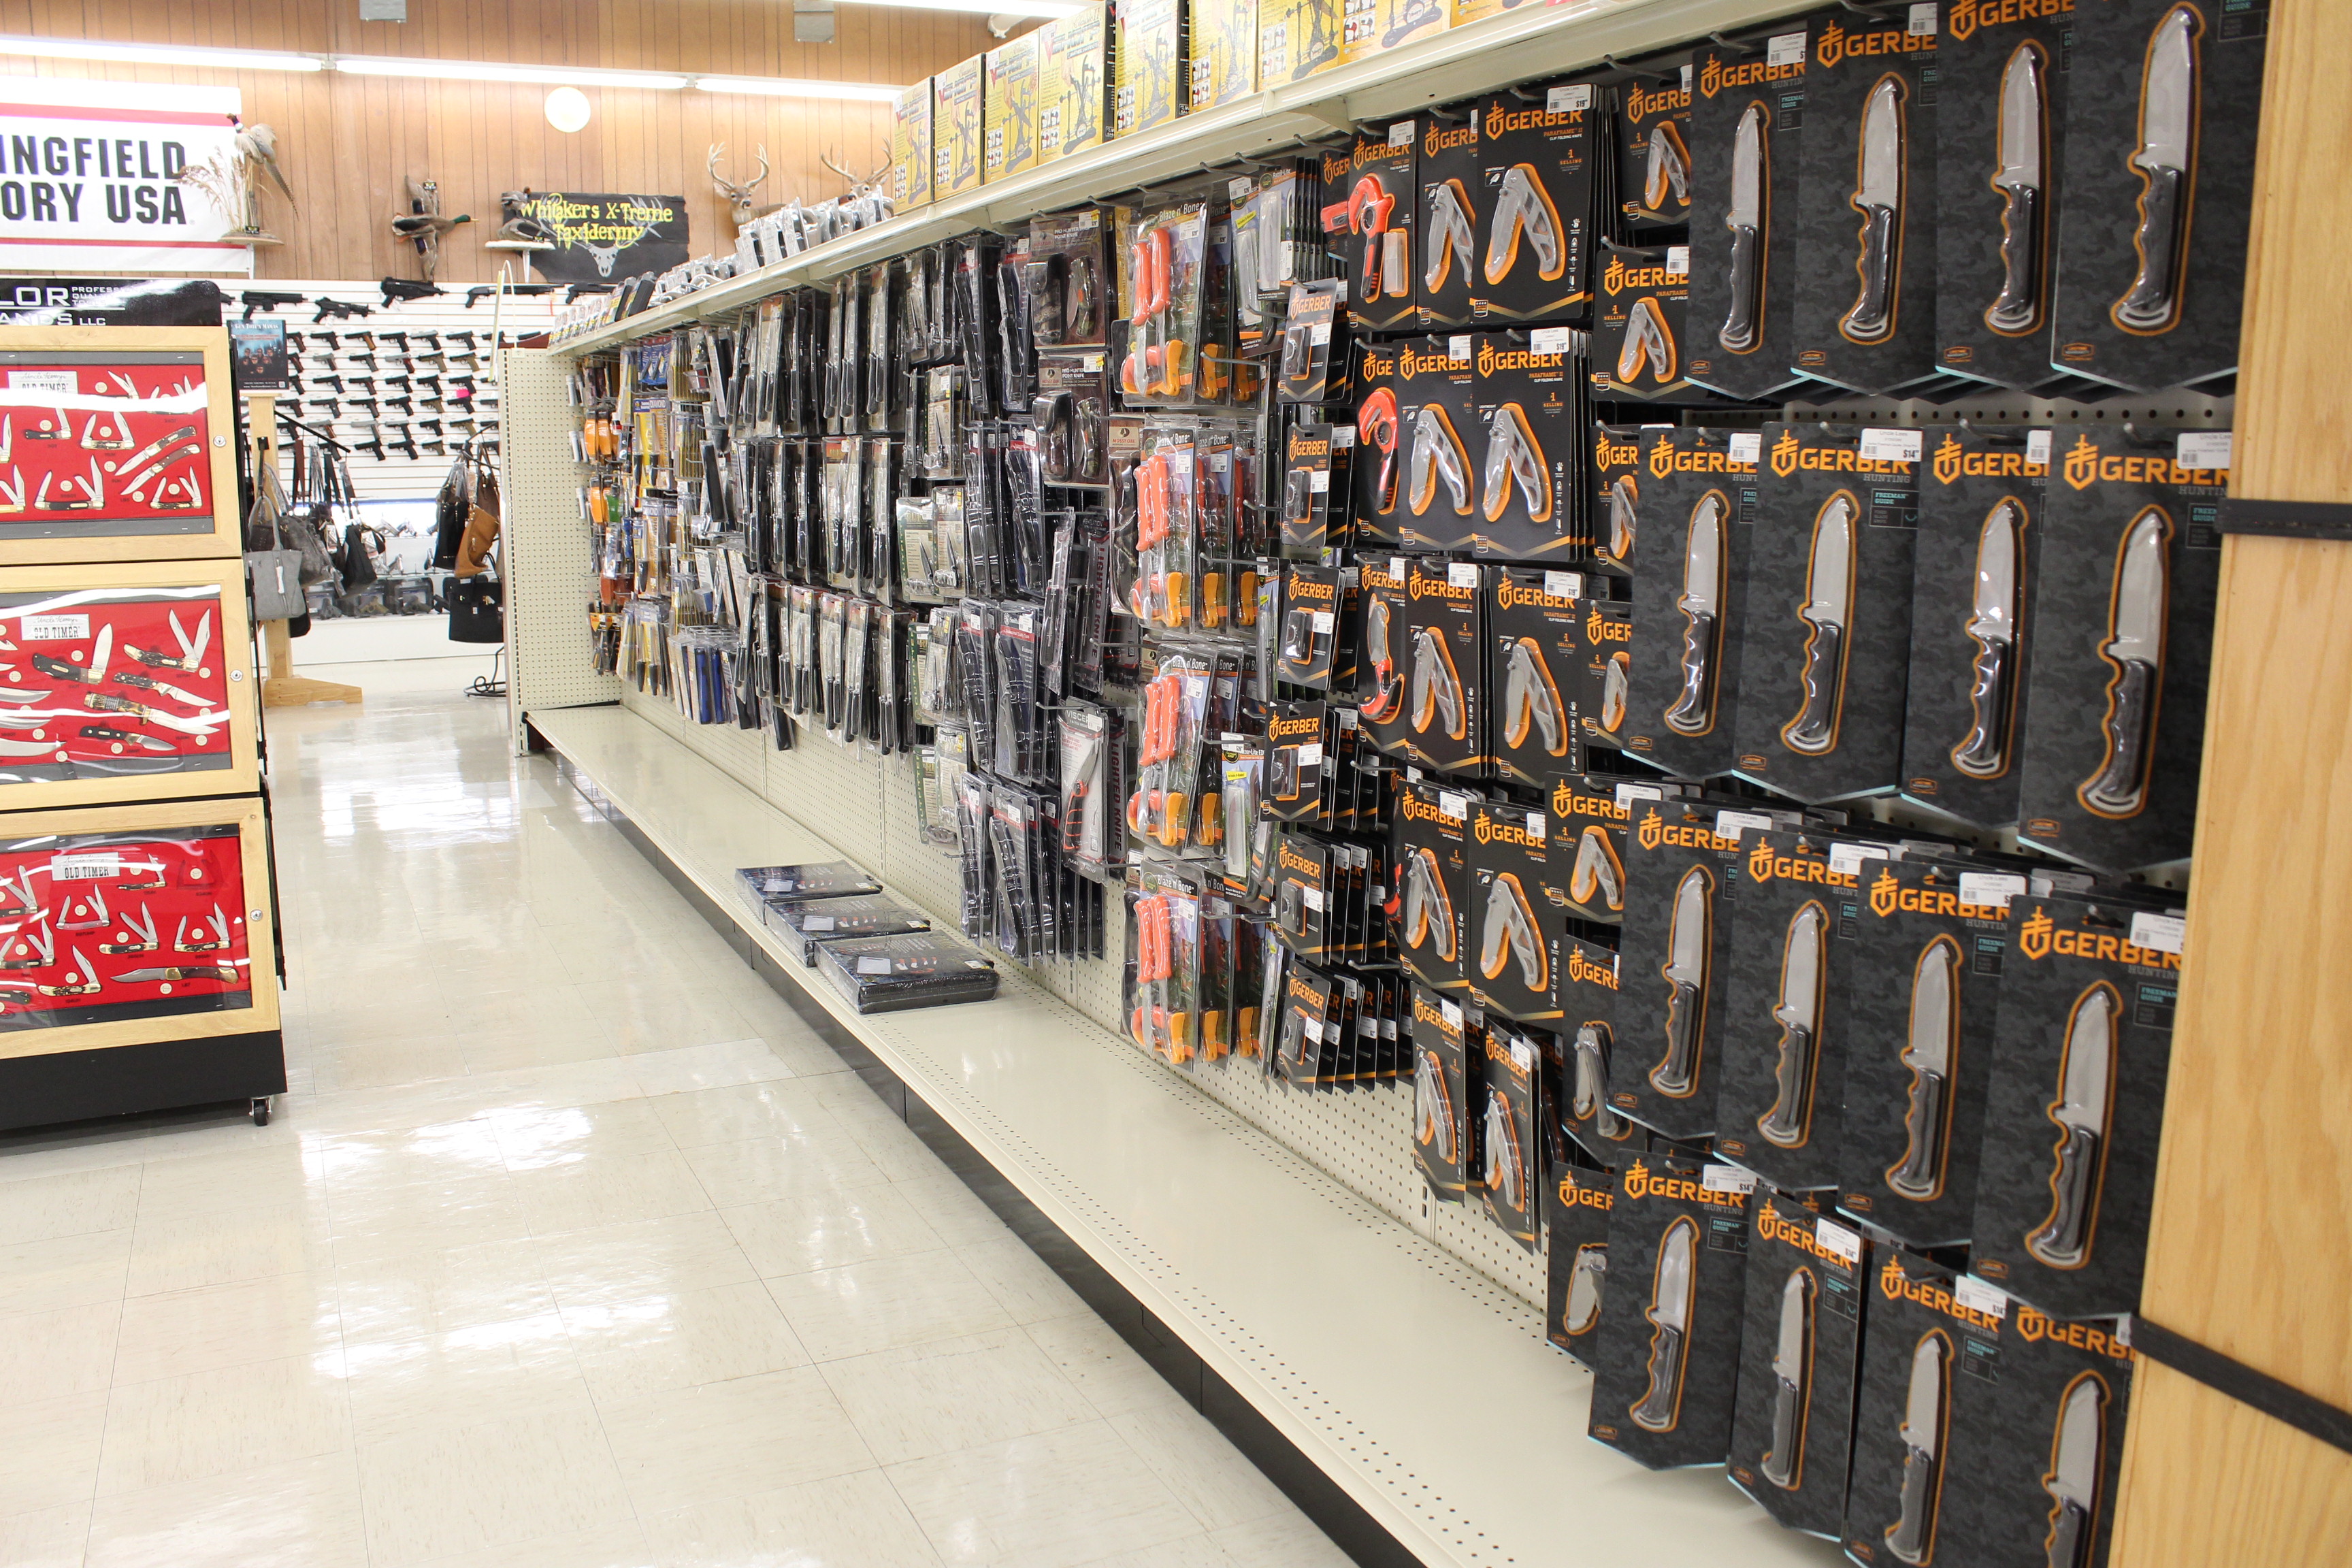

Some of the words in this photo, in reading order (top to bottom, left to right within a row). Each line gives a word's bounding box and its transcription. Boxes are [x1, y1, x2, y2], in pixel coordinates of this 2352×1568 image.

[1772, 77, 1803, 89] HUNTIN
[1646, 90, 1692, 114] GERB
[1505, 110, 1583, 131] GERBER
[1365, 143, 1410, 163] GERBER
[1333, 158, 1350, 176] GER
[1, 181, 83, 222] ORY
[106, 184, 186, 225] USA
[606, 202, 673, 224] X-Treme
[1159, 211, 1175, 222] Blaze
[553, 223, 645, 250] Taxidermy
[1298, 295, 1330, 312] GERBER
[80, 318, 105, 326] LLC
[1494, 350, 1563, 370] GERBER
[1296, 440, 1328, 456] GERBER
[1611, 446, 1637, 464] GER
[1798, 448, 1911, 474] GERBER
[1963, 453, 2050, 476] GERB
[1863, 474, 1910, 483] HUNTING
[2179, 485, 2226, 495] HUNTIN
[1095, 547, 1105, 608] LIGHTED
[1297, 583, 1334, 600] GERBER
[1422, 578, 1473, 600] GERBER
[1513, 587, 1575, 608] GERBER
[34, 627, 49, 638] OLD
[52, 626, 79, 638] TIMER
[1601, 620, 1631, 640] GER
[1279, 717, 1319, 736] GERBER
[1111, 742, 1121, 803] LIGHTED
[1415, 802, 1463, 828] GERBER
[1573, 796, 1631, 820] GERB
[1114, 809, 1122, 851] KNIFE
[65, 867, 84, 879] OLD
[86, 866, 110, 877] TIMER
[1288, 858, 1320, 879] GERBER
[1157, 875, 1172, 887] Blaze
[1966, 919, 2007, 930] HUNTIN
[1295, 983, 1324, 1010] GERBER
[1423, 1006, 1460, 1040] GERBER
[1494, 1043, 1527, 1081] GERBER
[1648, 1177, 1746, 1209] GERBER
[1703, 1203, 1744, 1215] HUNTING
[1775, 1222, 1852, 1271] GERBER
[1903, 1281, 1999, 1334] GERBER
[2047, 1322, 2136, 1362] GERB
